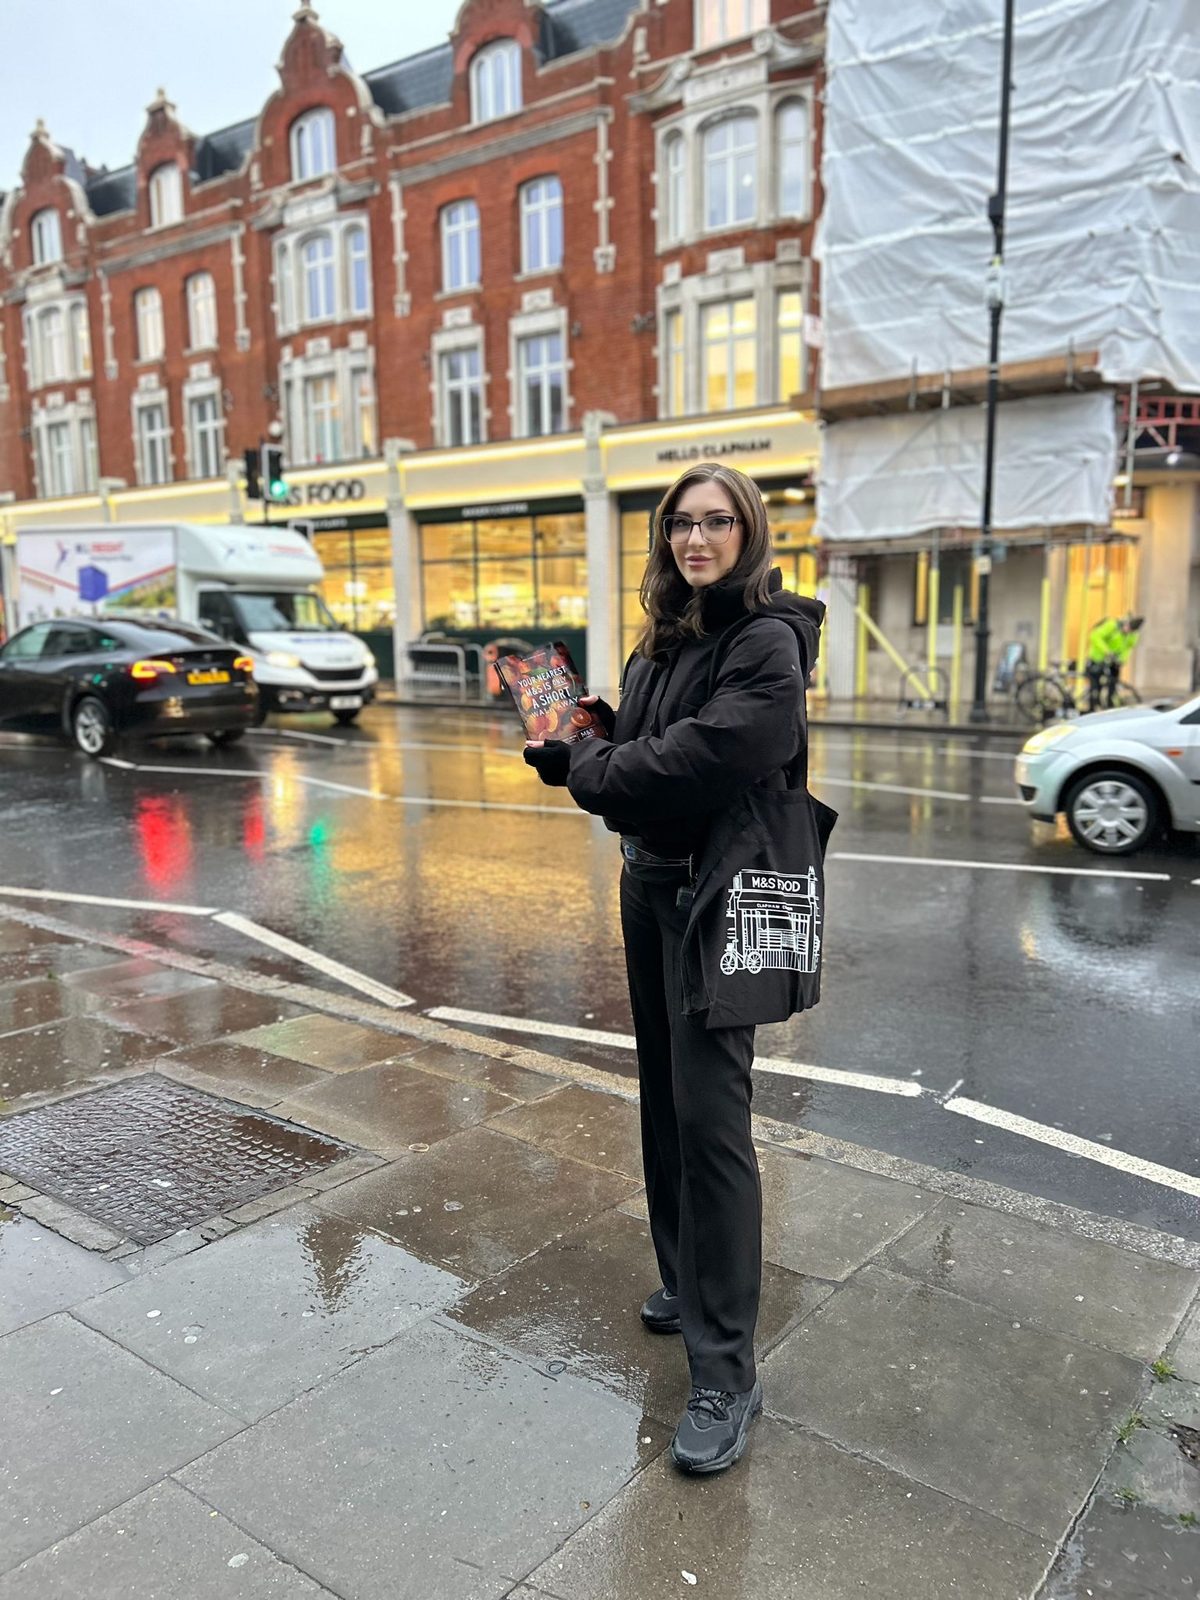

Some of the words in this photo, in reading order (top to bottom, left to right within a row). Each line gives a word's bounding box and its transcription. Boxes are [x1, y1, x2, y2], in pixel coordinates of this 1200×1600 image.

[657, 446, 699, 461] HELLO
[703, 439, 771, 457] CLAPHAM
[307, 480, 365, 504] FOOD
[518, 677, 537, 688] YOUR
[537, 665, 567, 681] NEAREST
[525, 685, 543, 697] M&S
[543, 681, 552, 692] IS
[552, 676, 567, 686] ONLY
[531, 706, 553, 718] WALK
[557, 696, 579, 710] AWAY
[532, 698, 540, 710] A
[539, 686, 571, 706] SHORT
[580, 728, 595, 737] M&S
[751, 876, 776, 889] M&S
